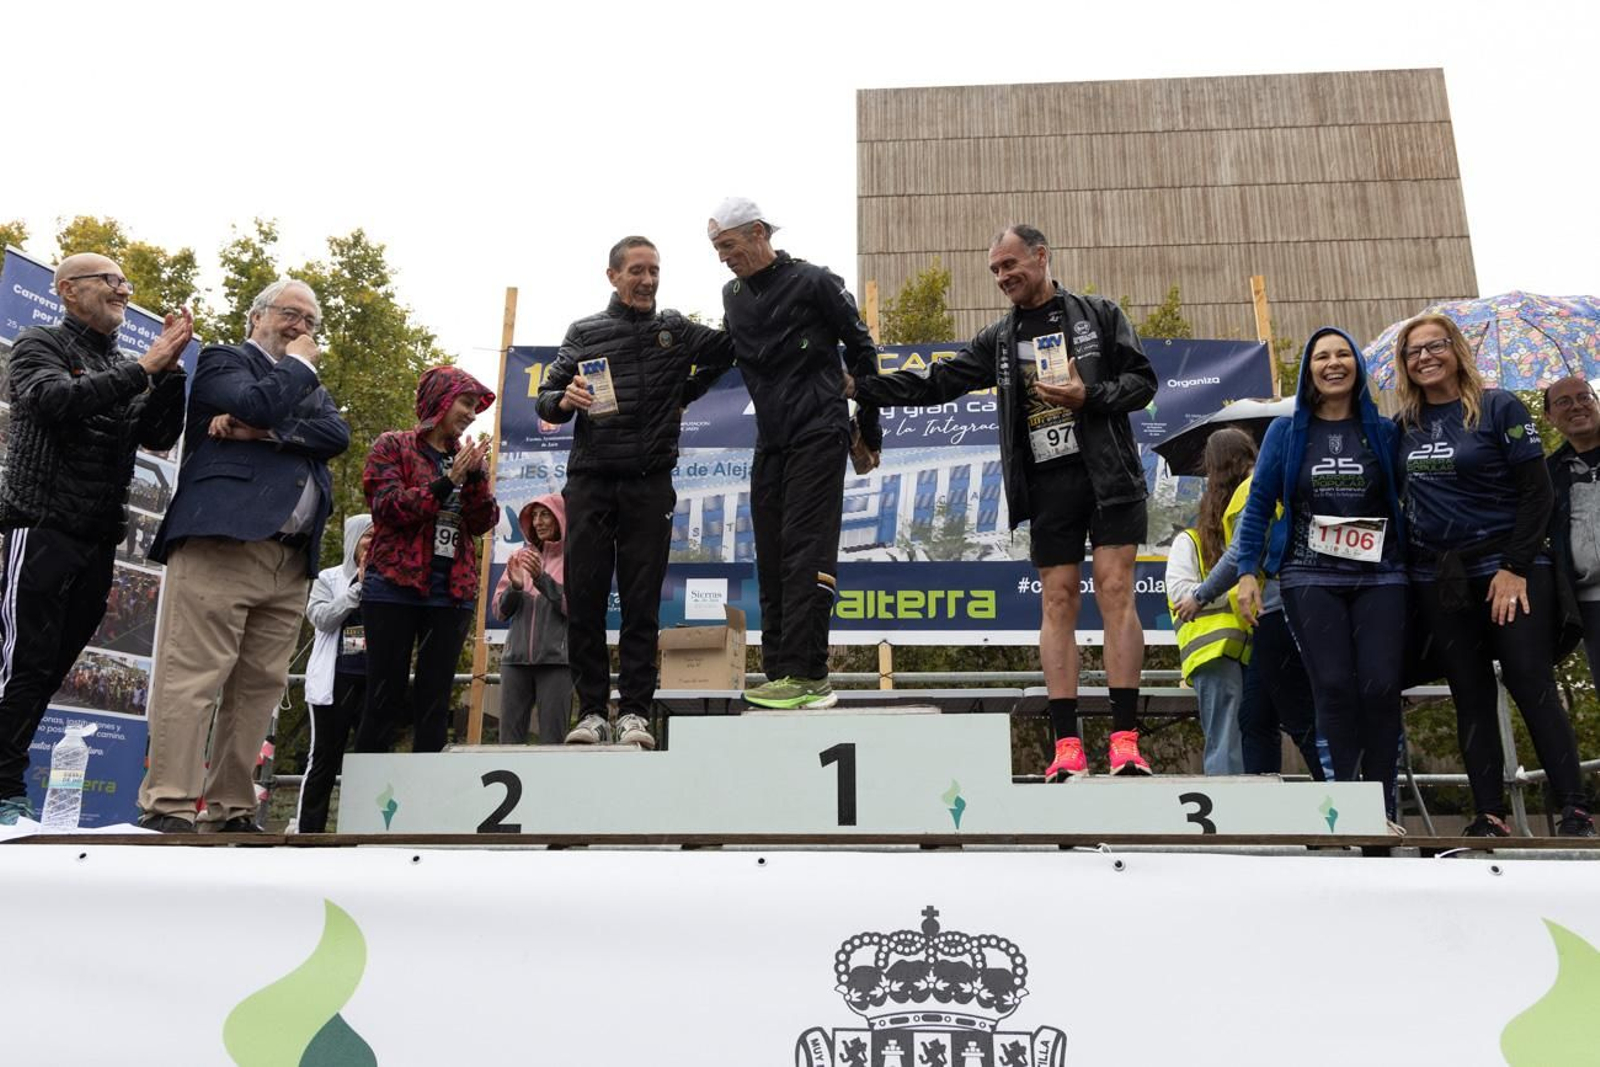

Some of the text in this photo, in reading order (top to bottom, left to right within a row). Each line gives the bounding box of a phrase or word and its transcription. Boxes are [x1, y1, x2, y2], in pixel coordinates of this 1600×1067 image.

[13, 284, 58, 311] Carrera
[122, 320, 137, 332] rio
[32, 308, 53, 323] por
[118, 333, 136, 346] ran
[1167, 377, 1220, 388] Organiza
[966, 401, 998, 413] ca
[896, 418, 917, 437] la
[922, 415, 999, 446] Integrac
[1046, 425, 1073, 447] 97
[1407, 441, 1454, 460] 25
[520, 464, 547, 480] IES
[686, 461, 708, 477] de
[1311, 457, 1364, 475] 25
[1318, 524, 1375, 551] 1106
[829, 589, 996, 620] alterra
[819, 743, 858, 827] 1
[476, 769, 523, 834] 2
[1178, 791, 1217, 834] 3
[810, 1037, 826, 1061] MUY
